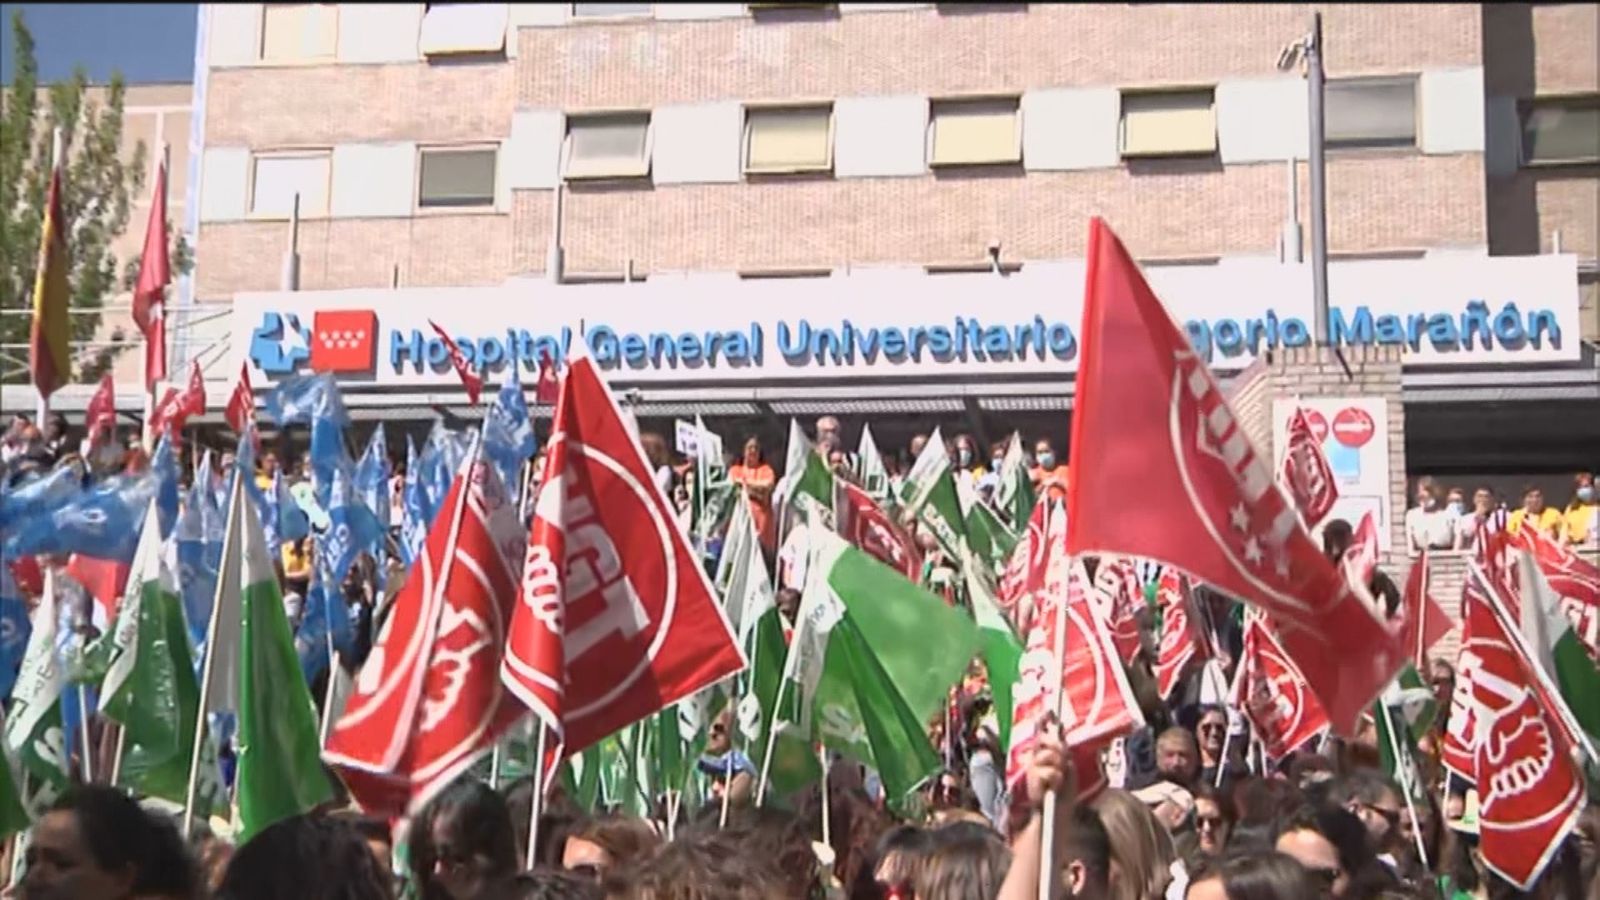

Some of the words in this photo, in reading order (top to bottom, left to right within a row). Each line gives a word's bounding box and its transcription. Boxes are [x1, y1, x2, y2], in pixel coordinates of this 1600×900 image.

[390, 326, 573, 376] Hospital
[585, 323, 763, 368] General
[777, 314, 1077, 366] Universitario
[1183, 308, 1311, 363] gorio
[1328, 298, 1562, 352] Marañón
